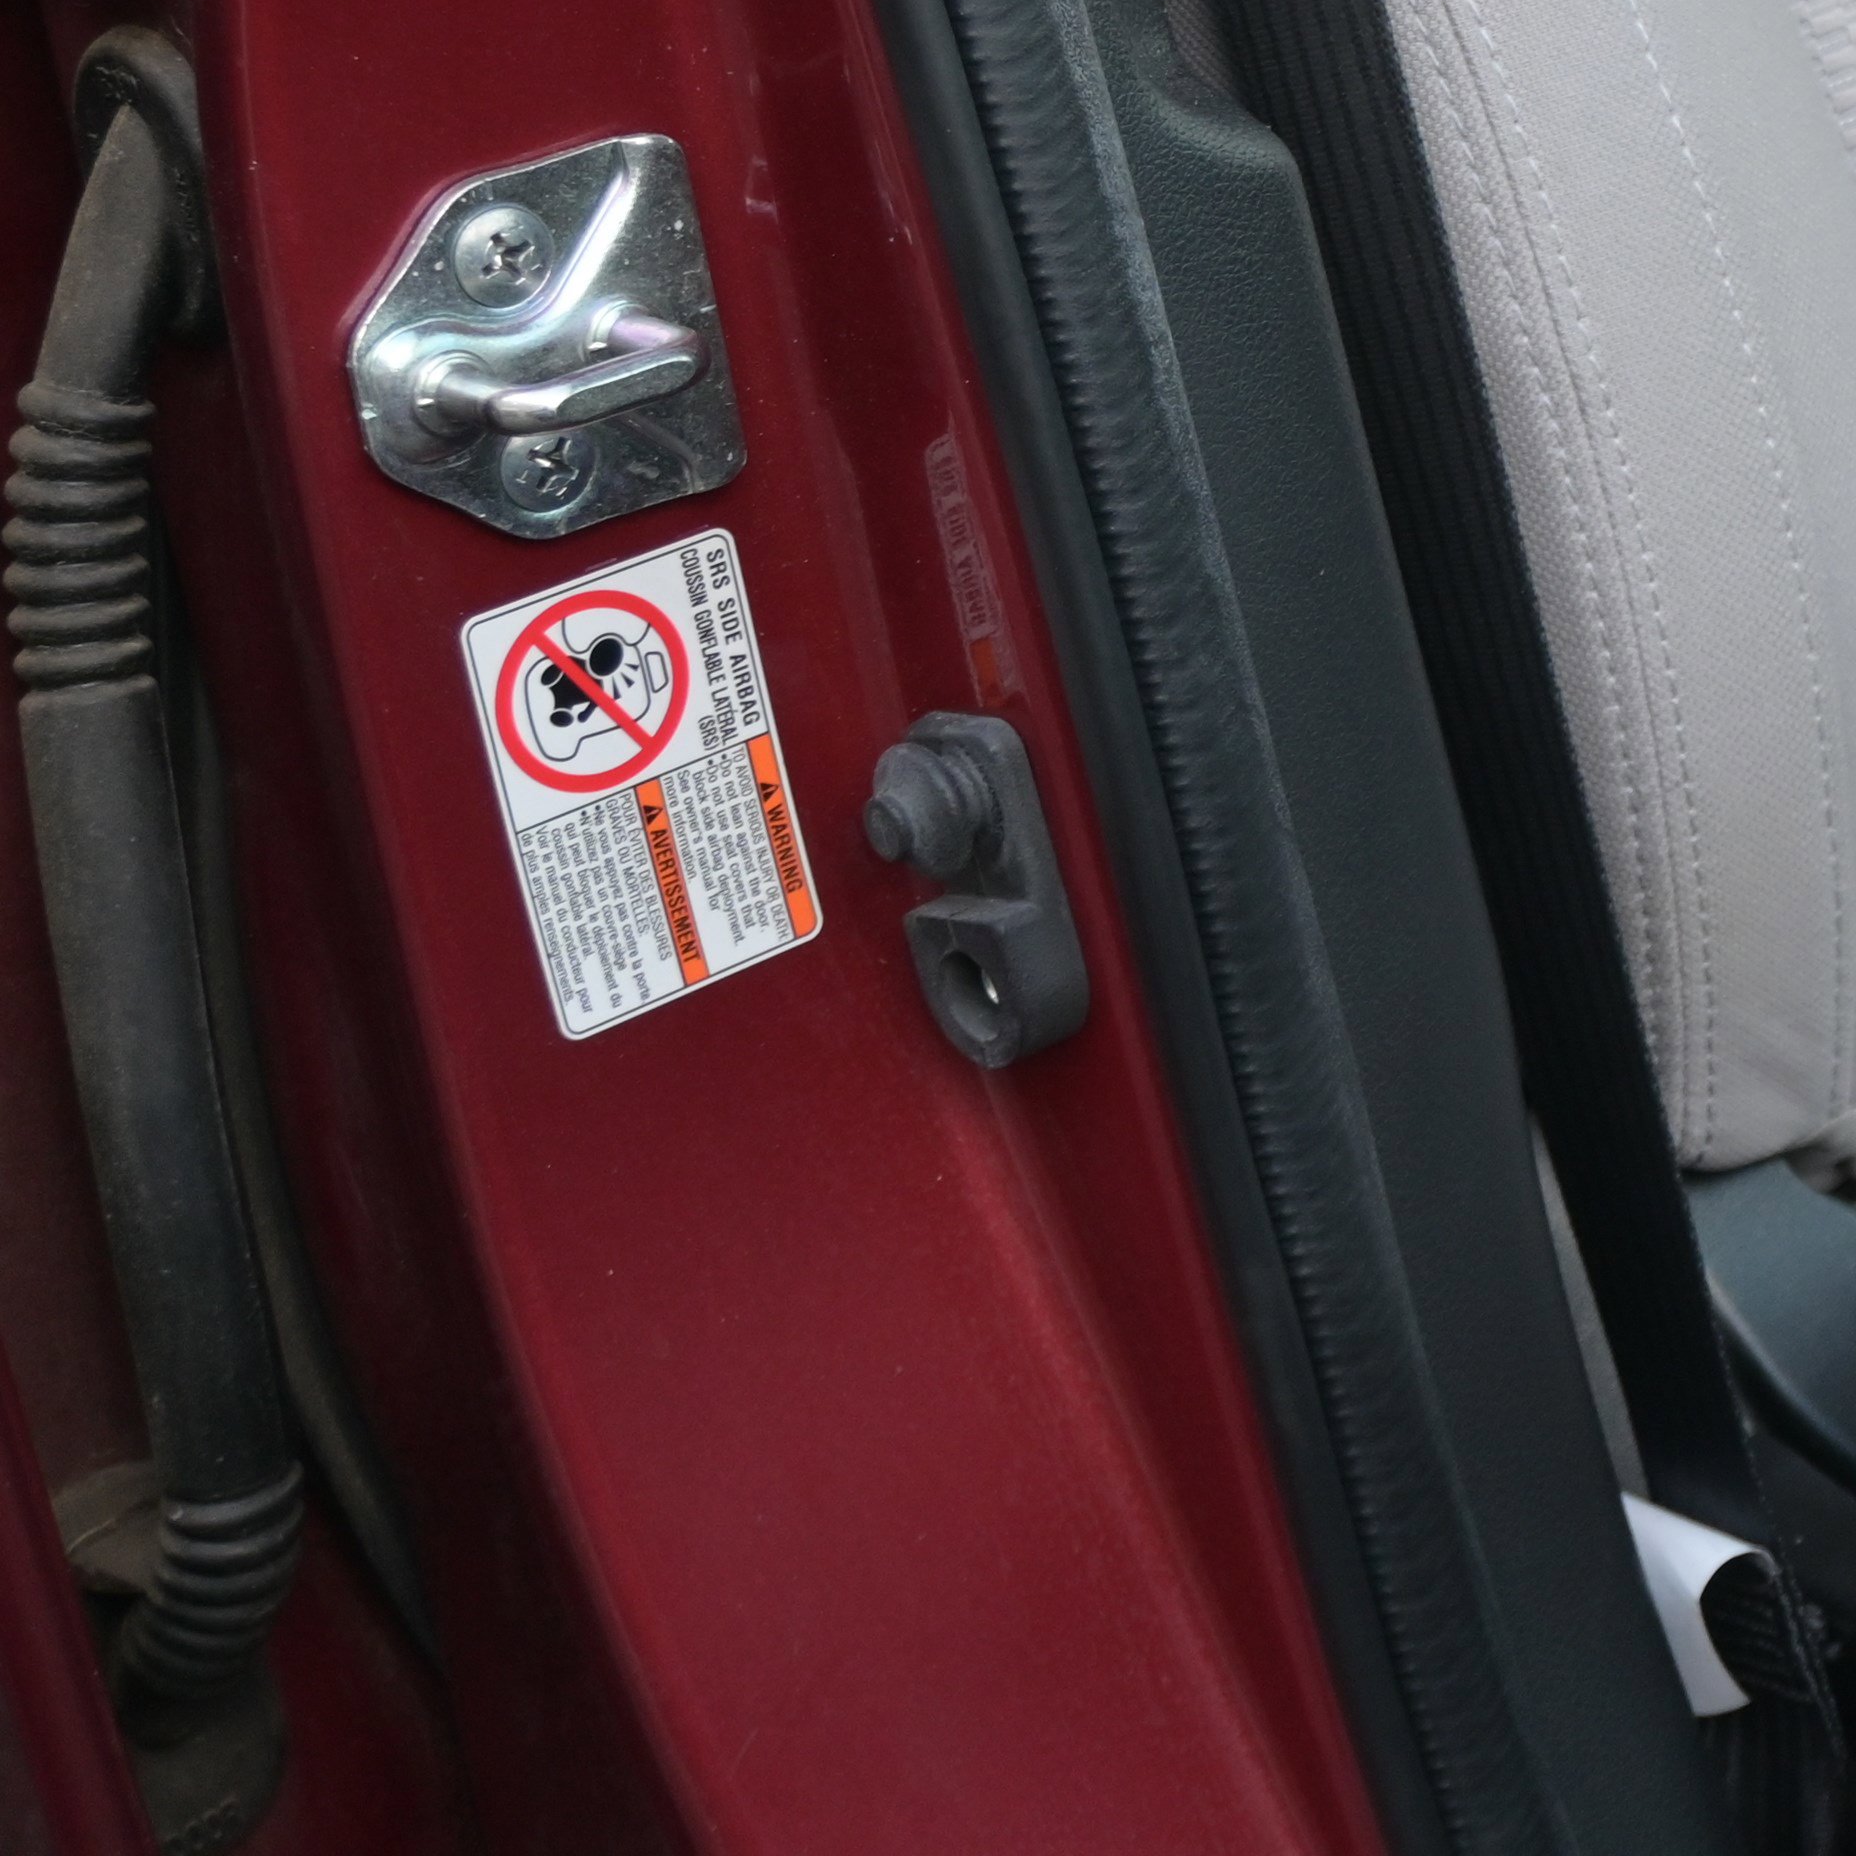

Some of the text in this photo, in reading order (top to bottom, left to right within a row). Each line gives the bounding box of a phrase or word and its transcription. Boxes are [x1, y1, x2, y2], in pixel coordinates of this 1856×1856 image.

[678, 547, 744, 745] COUSSIN GONFLABLE LATÉRAL
[705, 547, 761, 726] SRS SIDE AIRBAG
[697, 713, 721, 752] (SRS)
[730, 746, 746, 763] TO
[710, 784, 726, 807] not
[723, 779, 739, 801] not
[734, 762, 754, 797] AVOID
[562, 821, 578, 841] qui
[662, 774, 700, 883] more information.
[716, 808, 732, 831] use
[729, 802, 747, 829] lean
[743, 798, 765, 845] SERIOUS
[549, 826, 570, 870] coussin
[567, 841, 585, 868] peut
[597, 827, 613, 855] vous
[676, 768, 722, 912] See owner's manual for
[691, 769, 746, 947] block side airbag deployment.
[722, 832, 739, 859] seat
[734, 829, 758, 876] against
[765, 802, 803, 894] WARNING
[589, 864, 605, 886] pas
[601, 855, 625, 901] appuyez
[604, 797, 651, 937] GRAVES OU MORTELLES:
[618, 792, 673, 962] POUR ÉVITER DES BLESSURES
[729, 860, 749, 902] covers
[755, 845, 776, 885] INJURY
[559, 871, 584, 922] gonflable
[574, 868, 596, 911] bloquer
[596, 886, 610, 902] un
[650, 825, 701, 966] AVERTISSEMENT
[748, 876, 763, 897] the
[765, 884, 780, 902] OR
[520, 831, 576, 1007] de plus amples renseignements.
[534, 825, 593, 1015] Voir le manuel du conducteur pour
[588, 911, 600, 924] le
[613, 900, 630, 923] pas
[740, 902, 757, 929] that
[753, 898, 772, 932] door.
[599, 902, 628, 972] couvre-siège
[621, 922, 640, 958] contre
[631, 958, 644, 970] la
[609, 991, 623, 1008] du
[632, 970, 652, 1005] porte.
